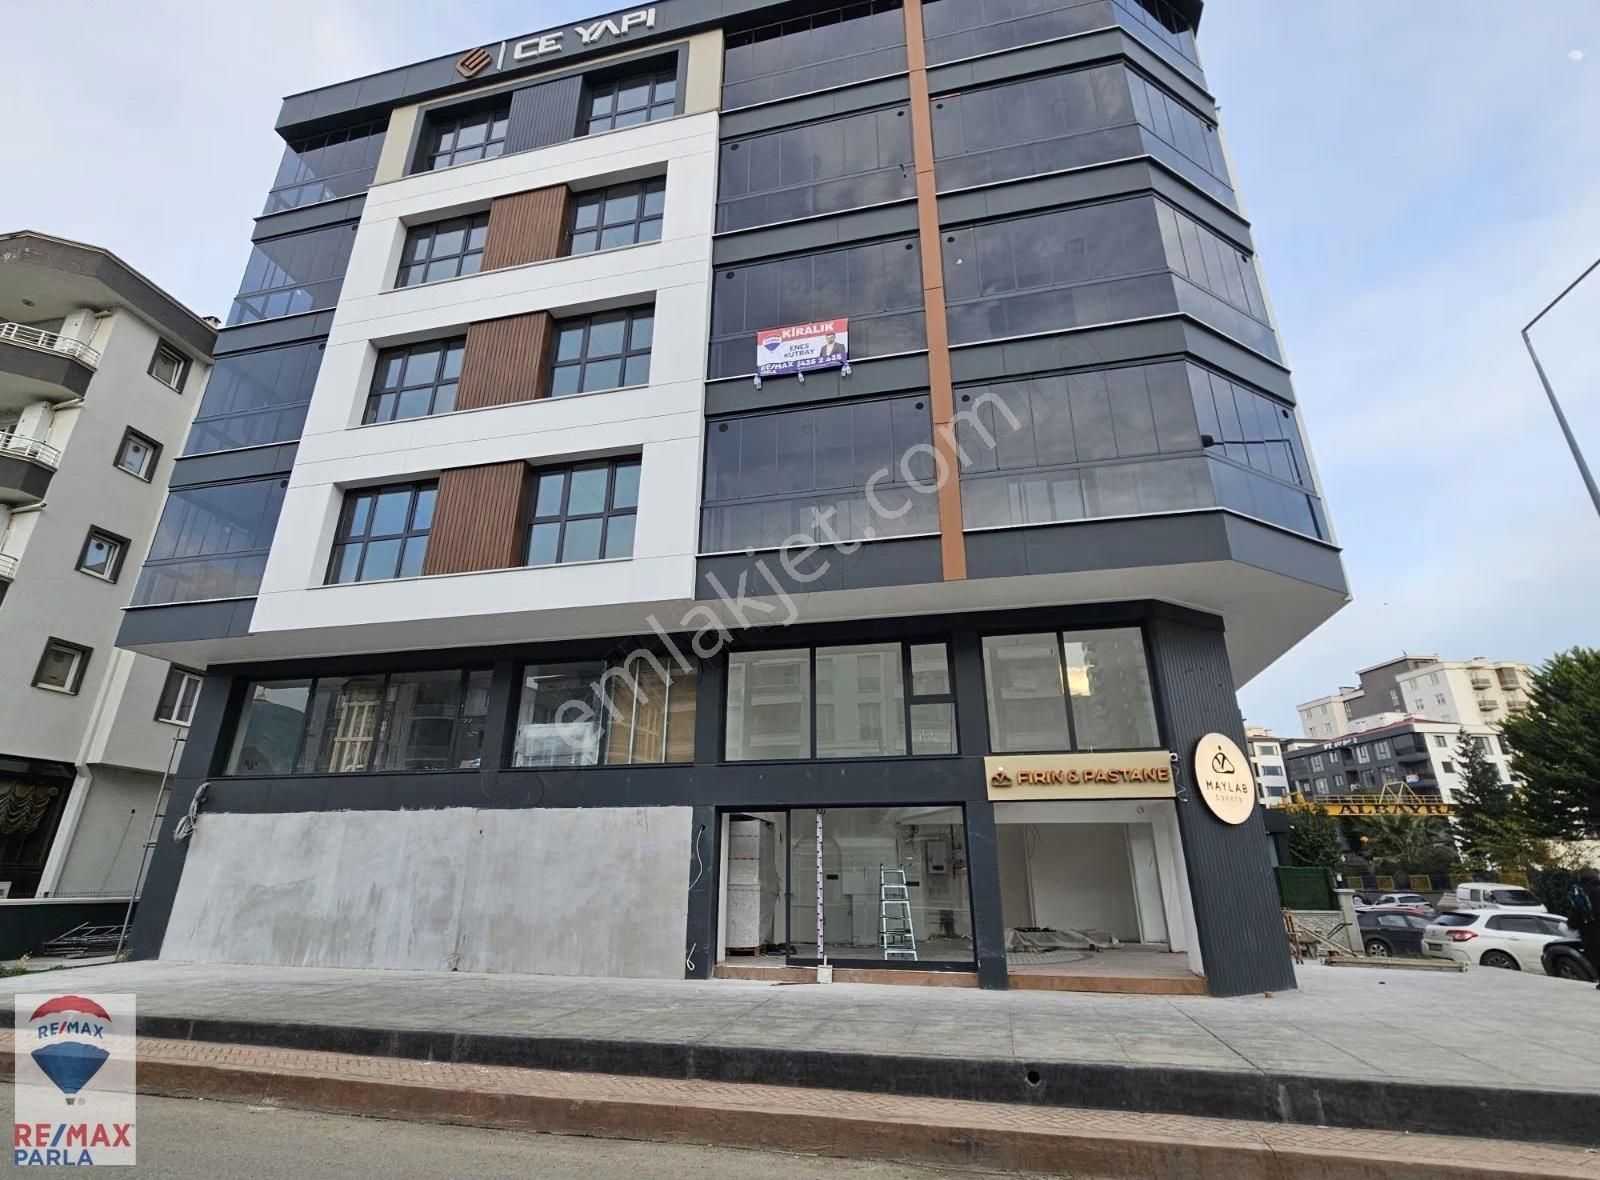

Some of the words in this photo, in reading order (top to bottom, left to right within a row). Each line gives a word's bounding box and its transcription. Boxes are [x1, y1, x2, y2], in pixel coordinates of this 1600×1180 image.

[513, 31, 564, 61] CE
[574, 8, 656, 46] YAPI
[782, 322, 834, 339] KİRALIK
[784, 348, 815, 358] KUTBAY
[789, 343, 810, 351] ENES
[760, 360, 794, 371] RE/MAX
[1017, 769, 1065, 785] FIRIN
[1066, 769, 1081, 784] &
[1082, 767, 1170, 784] PASTANE
[1205, 780, 1248, 794] MAYLAB
